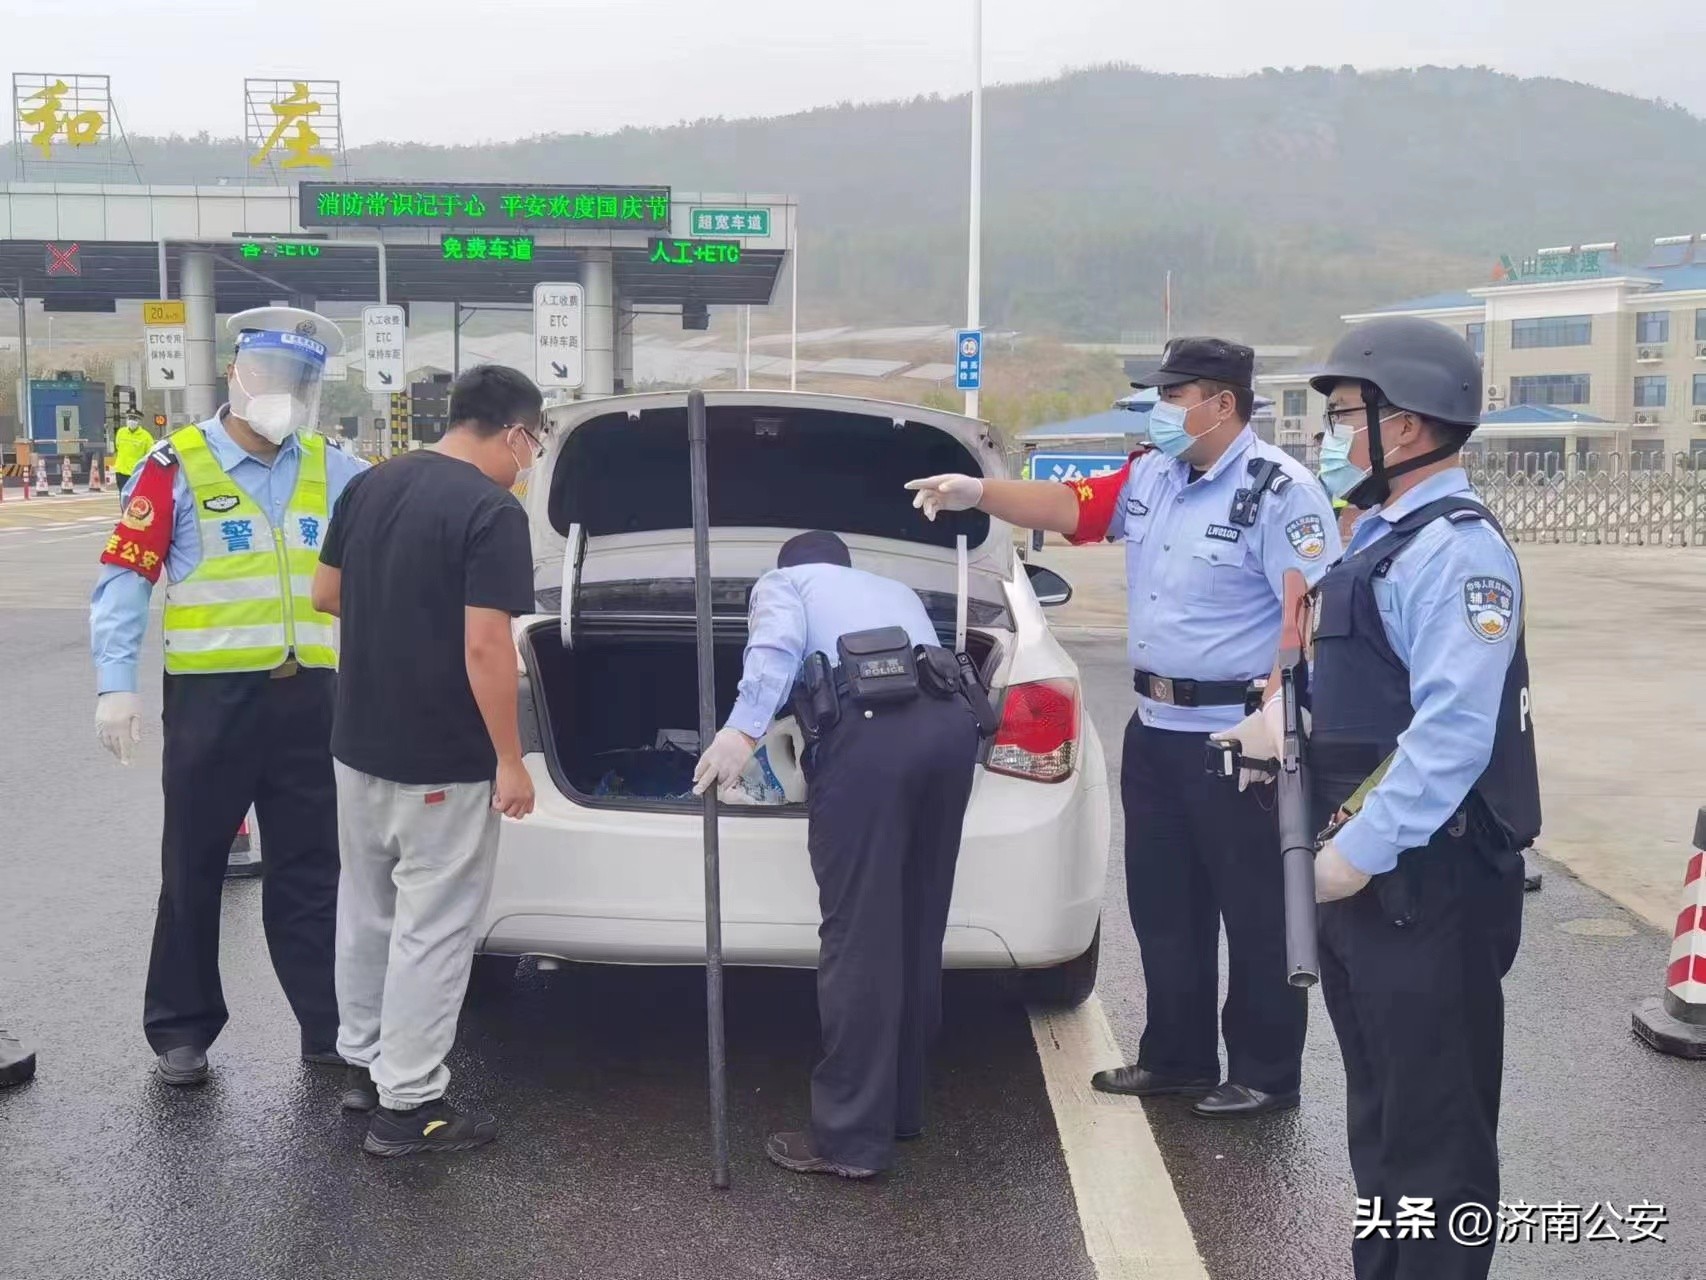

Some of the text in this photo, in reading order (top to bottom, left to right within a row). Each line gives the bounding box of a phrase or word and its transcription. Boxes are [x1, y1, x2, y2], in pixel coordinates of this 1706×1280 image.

[21, 79, 334, 169] 和 庄
[317, 191, 668, 220] 消防常识记于心 平安欢度国庆节
[697, 213, 763, 231] 超宽车道
[443, 236, 533, 262] 免费车道
[651, 242, 740, 265] 人工+ETC
[550, 314, 568, 328] ETC
[376, 332, 392, 343] ETC
[220, 517, 320, 552] 警 察
